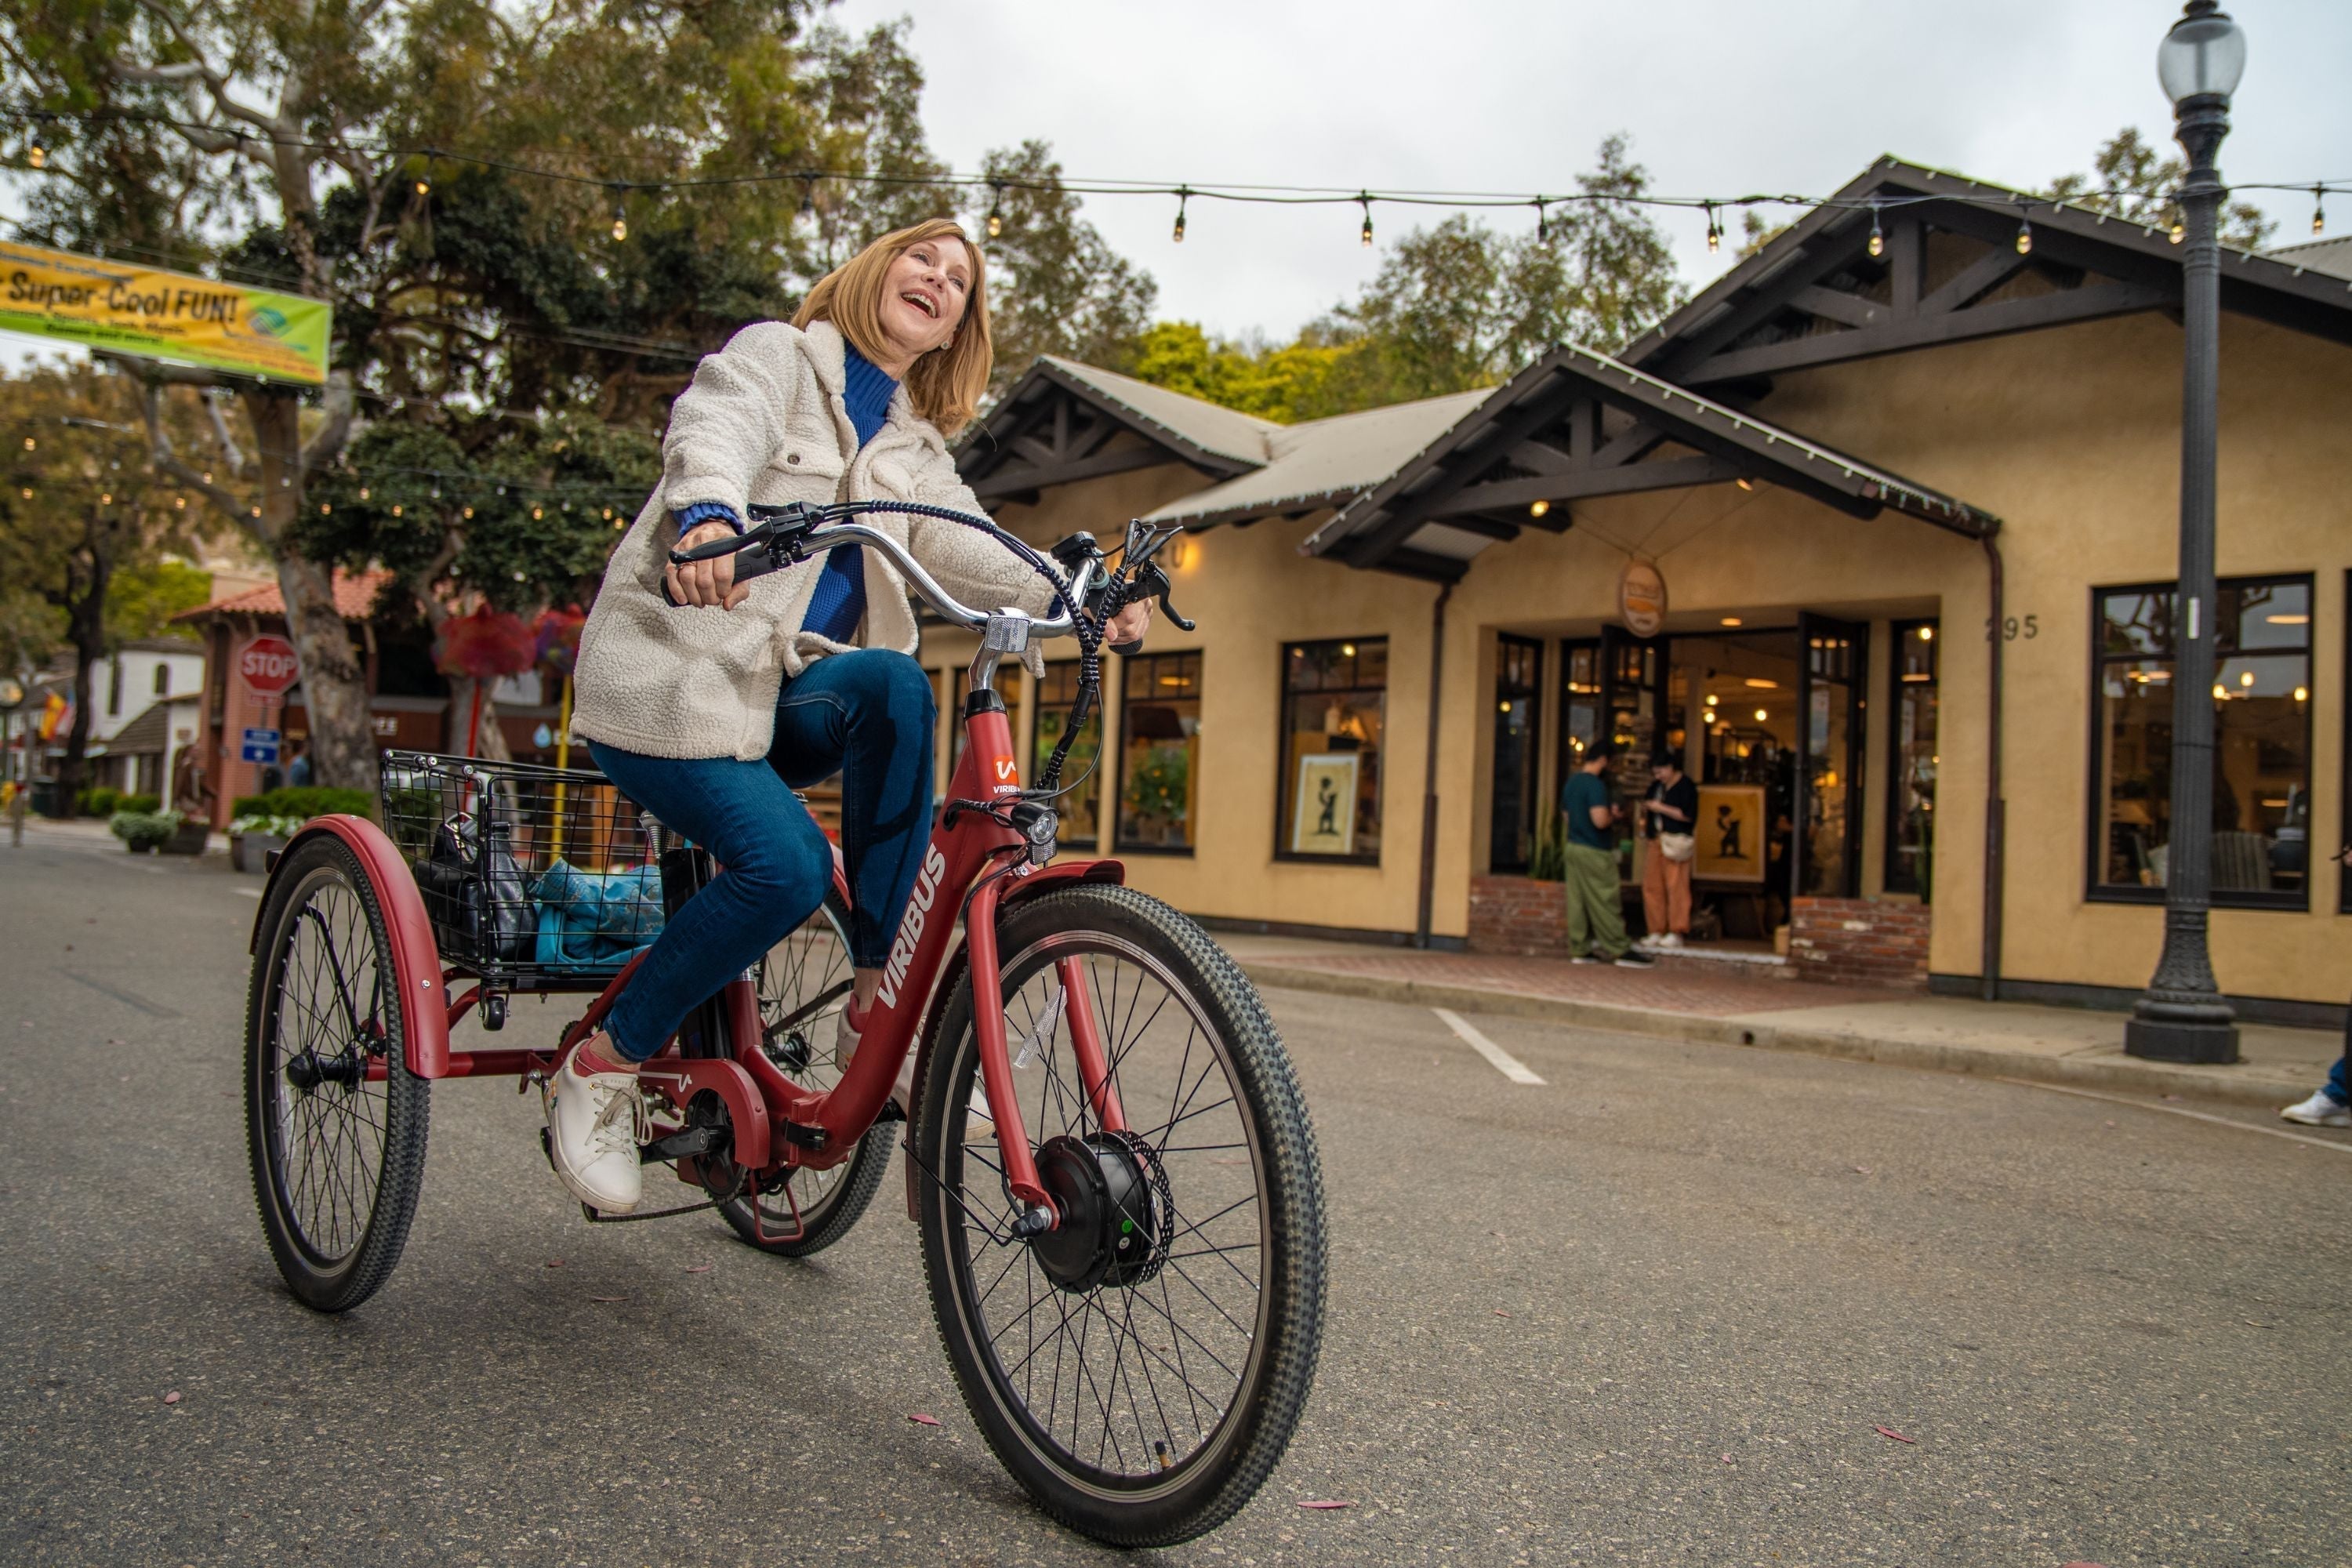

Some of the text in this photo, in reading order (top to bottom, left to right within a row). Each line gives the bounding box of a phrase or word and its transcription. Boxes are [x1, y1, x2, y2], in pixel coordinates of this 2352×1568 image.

[173, 289, 237, 324] FUN!
[243, 652, 296, 678] STOP
[993, 785, 1021, 793] VIRIBU
[877, 842, 946, 1009] VIRIBUS
